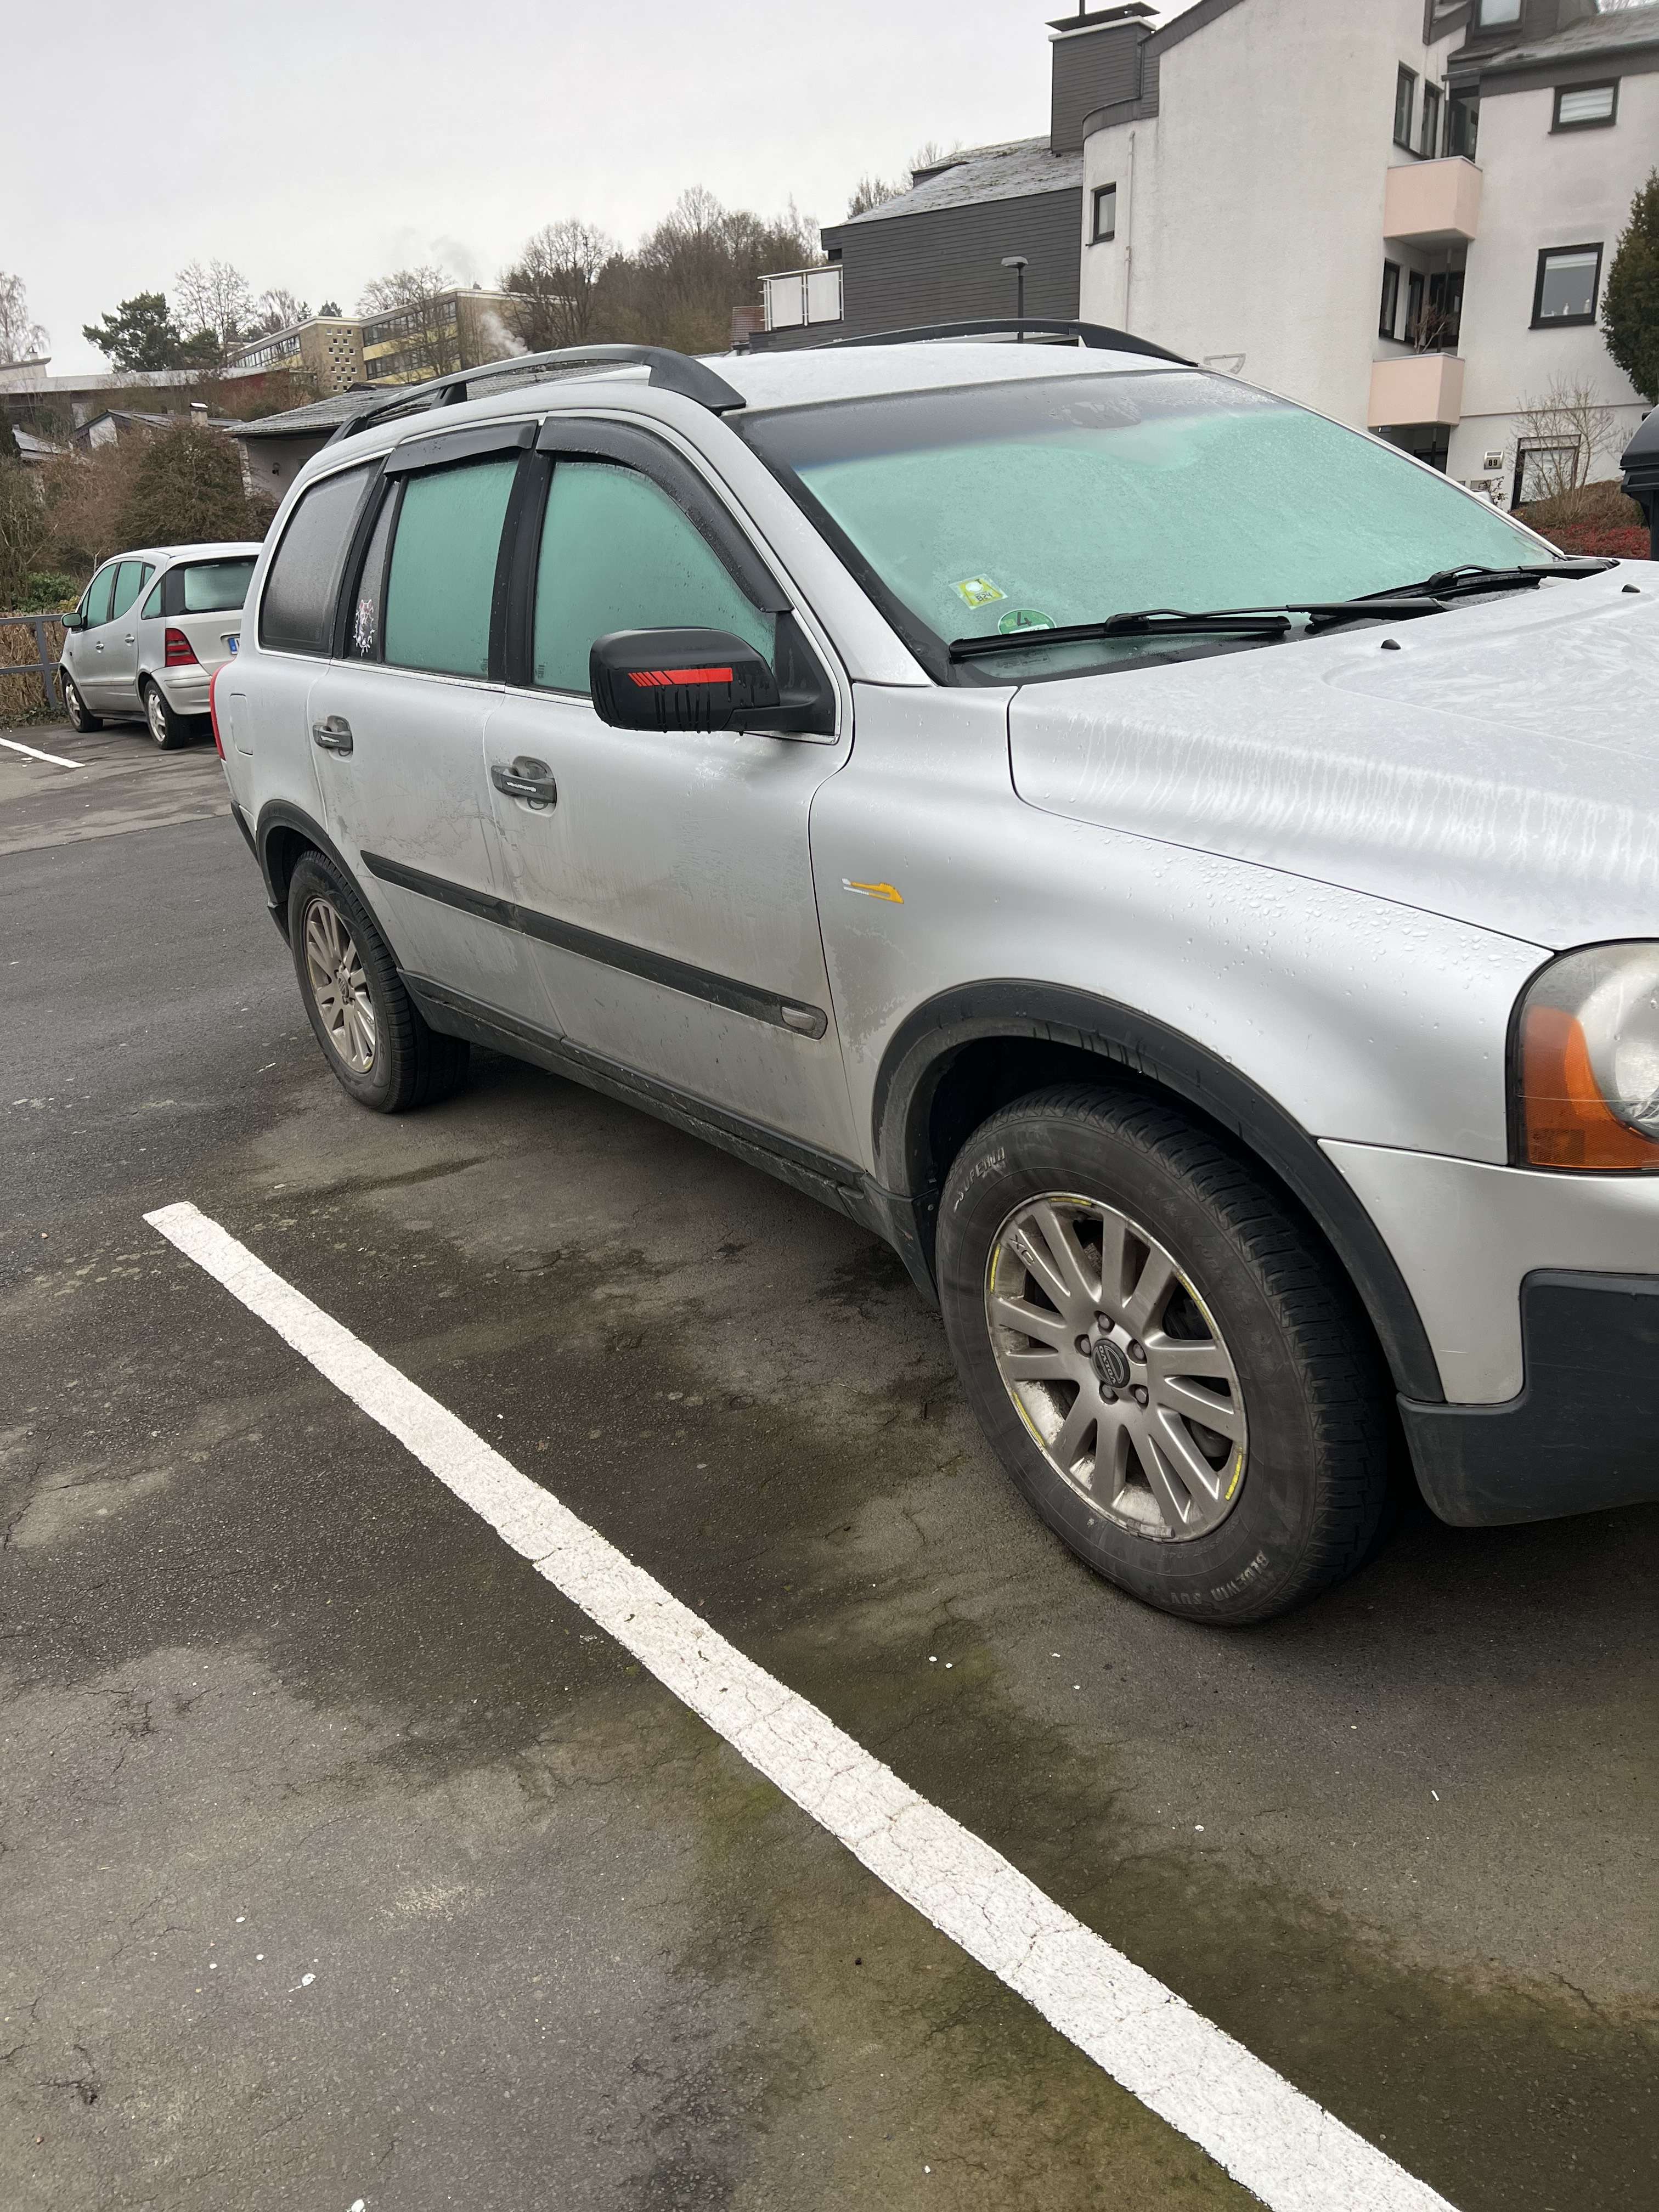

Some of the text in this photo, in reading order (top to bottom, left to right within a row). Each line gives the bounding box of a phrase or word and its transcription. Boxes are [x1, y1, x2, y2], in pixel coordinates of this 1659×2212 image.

[1017, 612, 1032, 627] 4
[1009, 1234, 1036, 1266] XC
[1098, 1345, 1117, 1385] VOLVO
[1170, 1592, 1203, 1605] SUV
